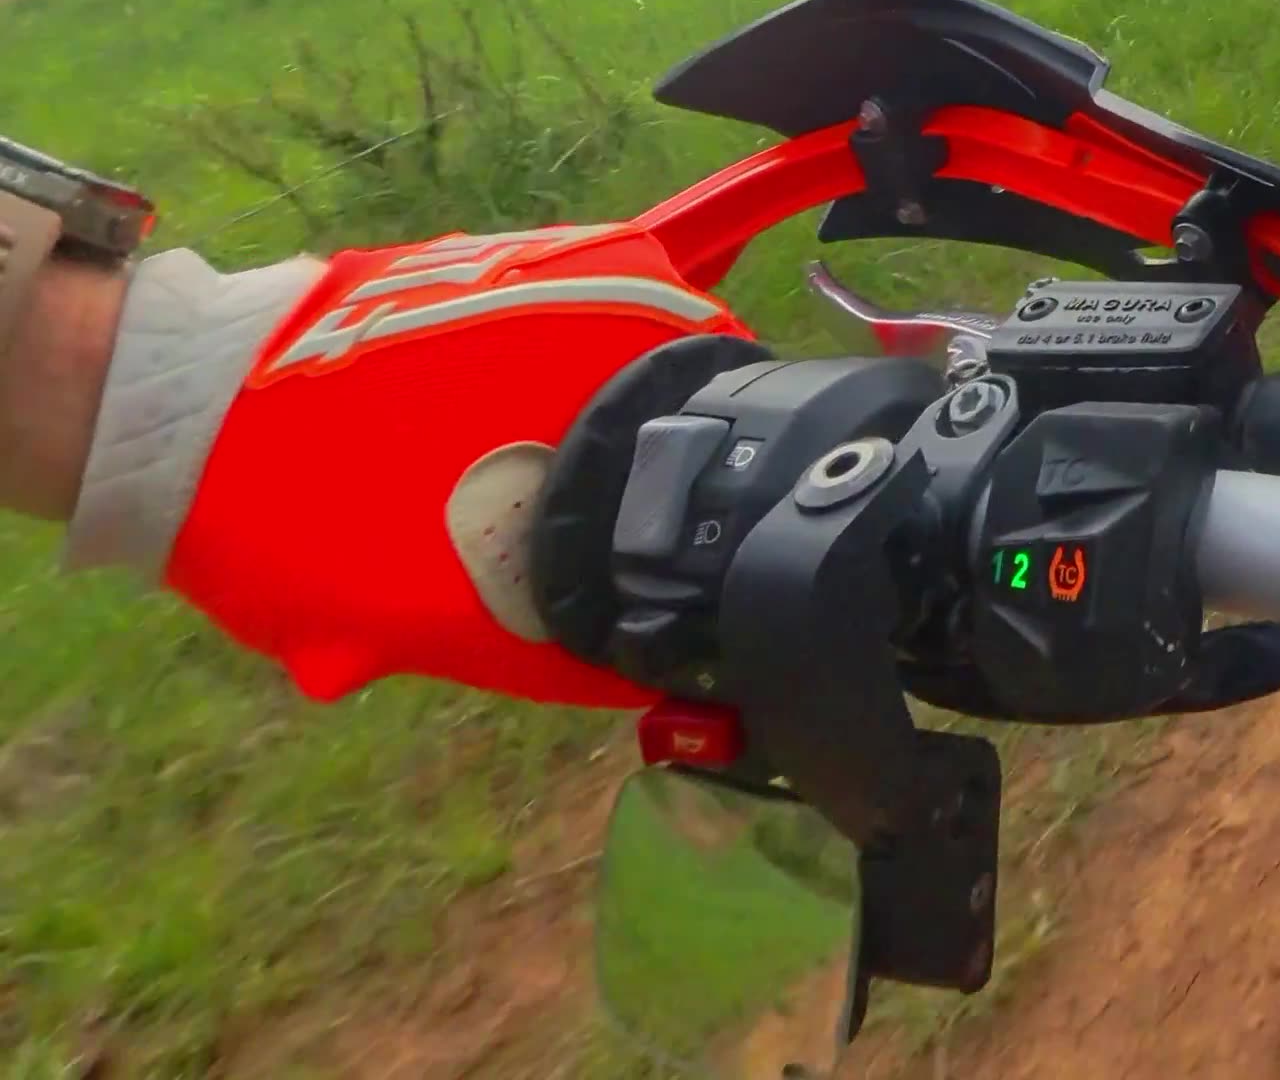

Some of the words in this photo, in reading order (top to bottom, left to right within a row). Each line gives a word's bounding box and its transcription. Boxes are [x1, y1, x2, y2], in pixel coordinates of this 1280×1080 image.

[1063, 297, 1172, 311] MAGURA
[1076, 315, 1101, 323] use
[1105, 314, 1136, 325] only
[1010, 551, 1029, 590] 2
[1057, 564, 1077, 584] TC
